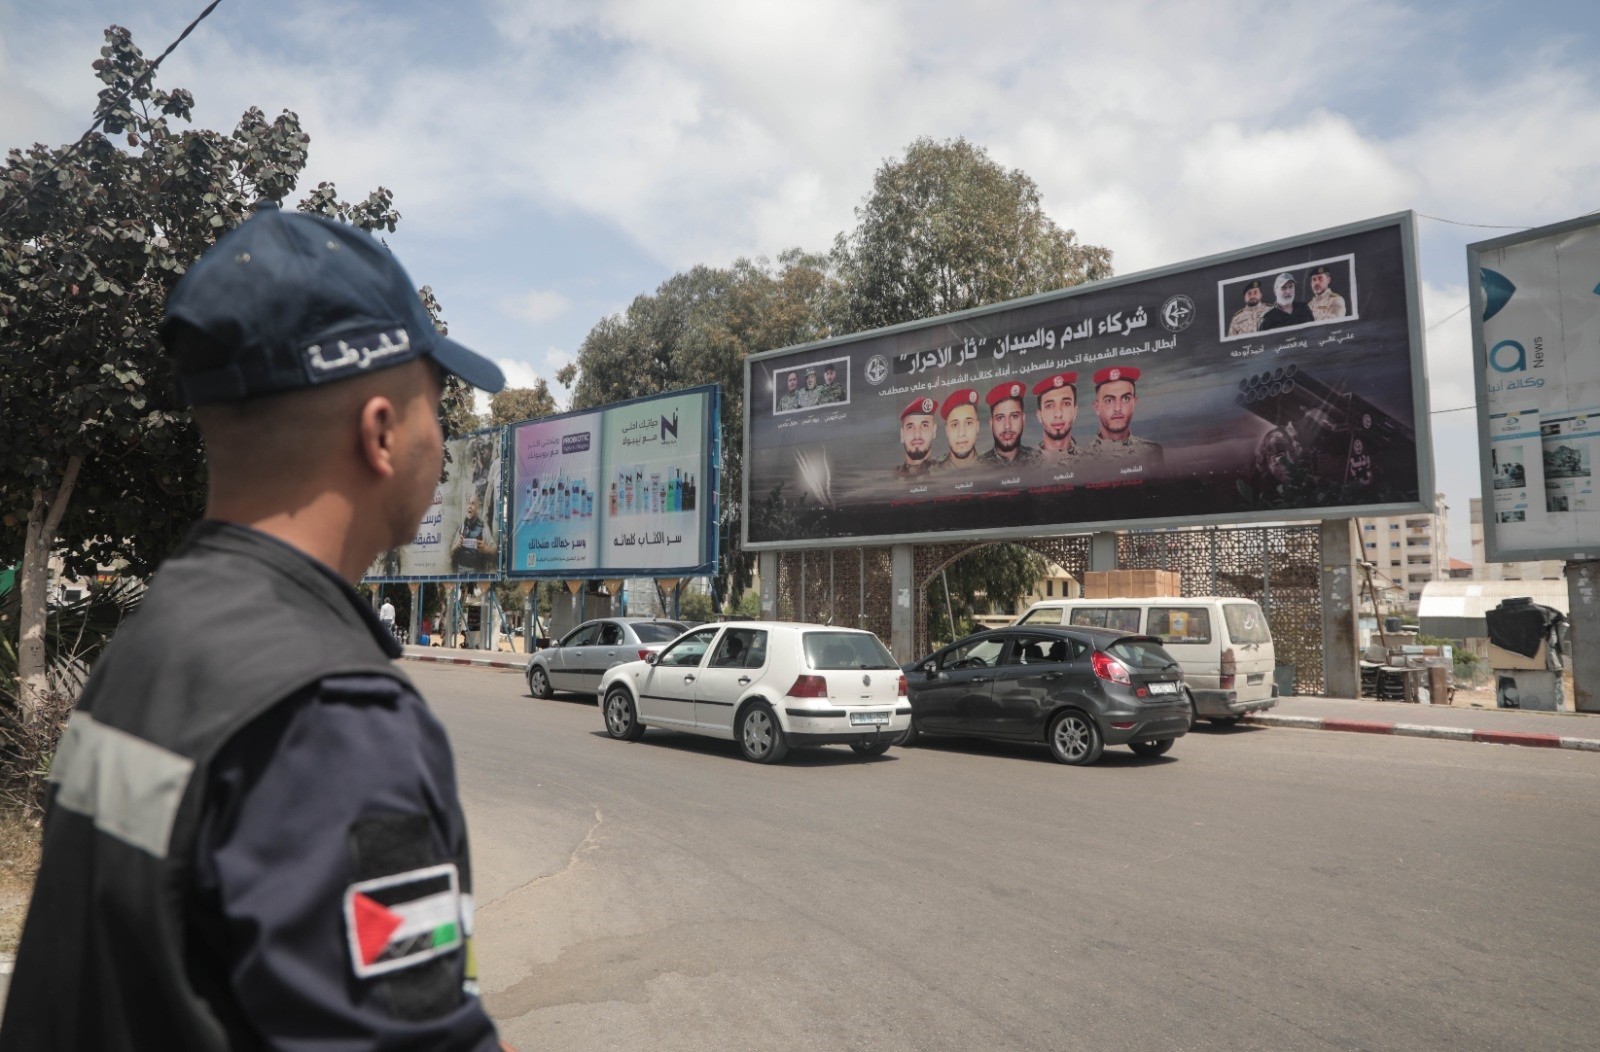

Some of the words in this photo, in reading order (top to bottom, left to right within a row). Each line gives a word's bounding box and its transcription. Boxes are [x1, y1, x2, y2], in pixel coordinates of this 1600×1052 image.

[1098, 305, 1148, 336] شركاء
[1060, 318, 1093, 349] الدم
[993, 327, 1056, 360] والميدان
[1119, 341, 1151, 357] الجبهة
[1152, 333, 1177, 353] أبطال
[1083, 347, 1118, 363] الشعبية
[1533, 336, 1545, 369] News
[1019, 360, 1055, 375] فلسطين
[1056, 353, 1082, 369] لتحرير
[941, 373, 969, 386] الشهيد
[970, 369, 993, 382] كتائب
[1507, 376, 1545, 390] وكالة
[878, 385, 909, 396] مصطفى
[910, 381, 926, 393] علي
[1053, 472, 1075, 481] الشهيد
[1120, 465, 1143, 475] الشهيد
[954, 481, 974, 490] الشهيد
[1001, 477, 1020, 486] الشهيد
[420, 511, 442, 526] فرس
[638, 531, 665, 548] الكتاب
[666, 533, 682, 546] سر
